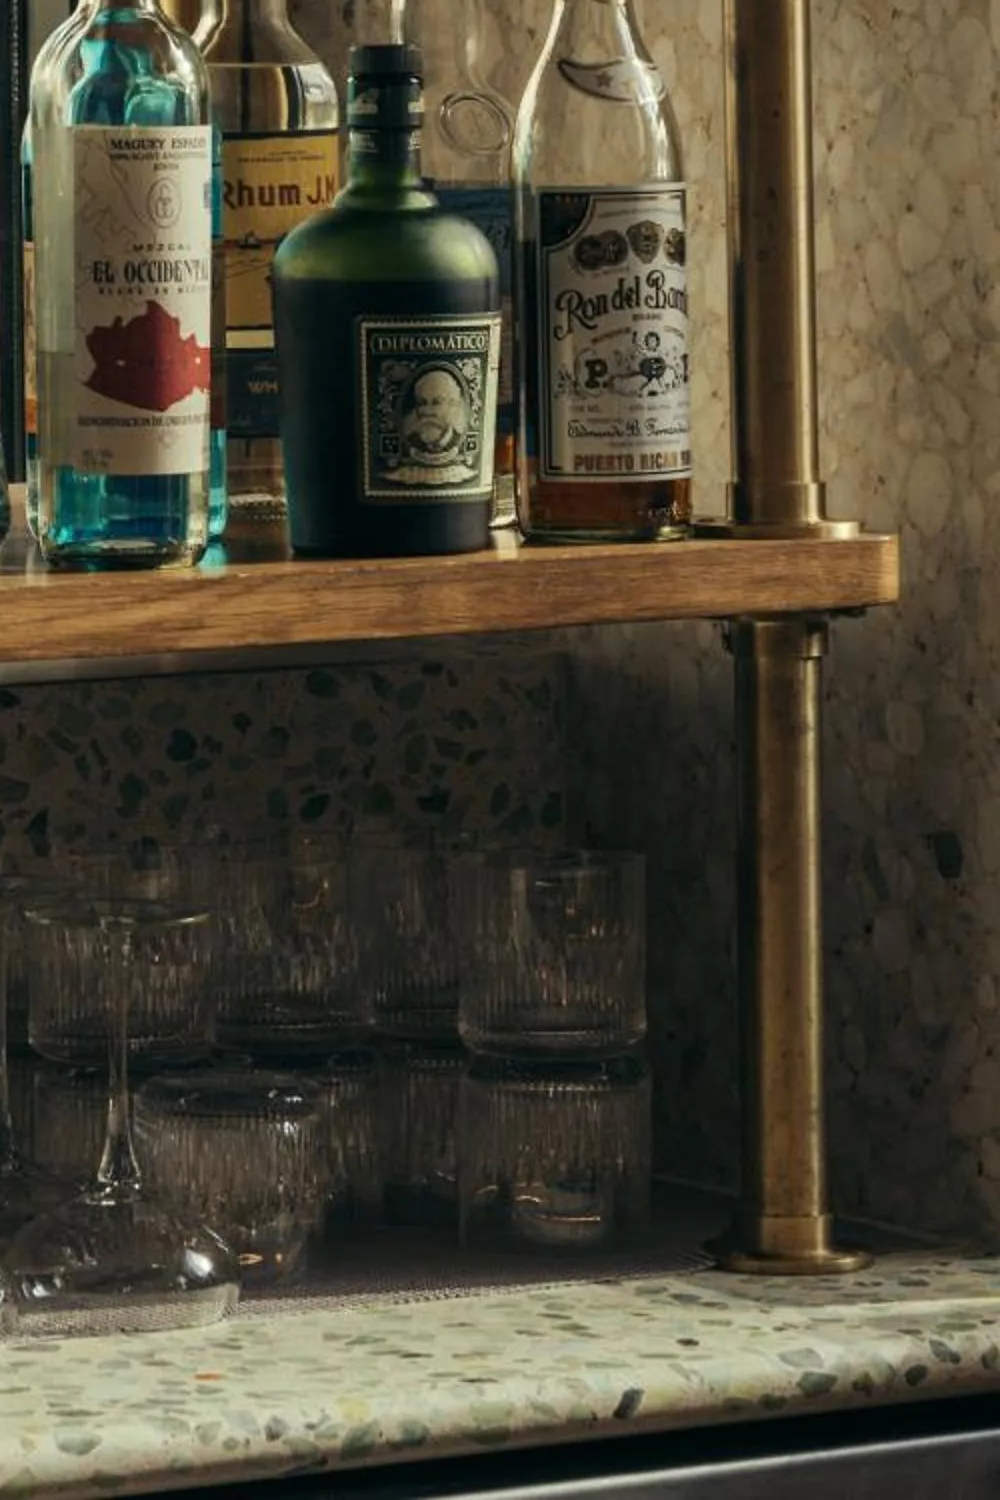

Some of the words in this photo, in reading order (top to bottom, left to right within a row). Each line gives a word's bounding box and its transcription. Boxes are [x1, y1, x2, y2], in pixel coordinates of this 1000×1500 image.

[110, 138, 165, 150] MAGUEY
[92, 260, 115, 283] EL
[553, 288, 610, 341] Ron
[611, 275, 641, 311] del
[573, 453, 635, 472] PUERTO
